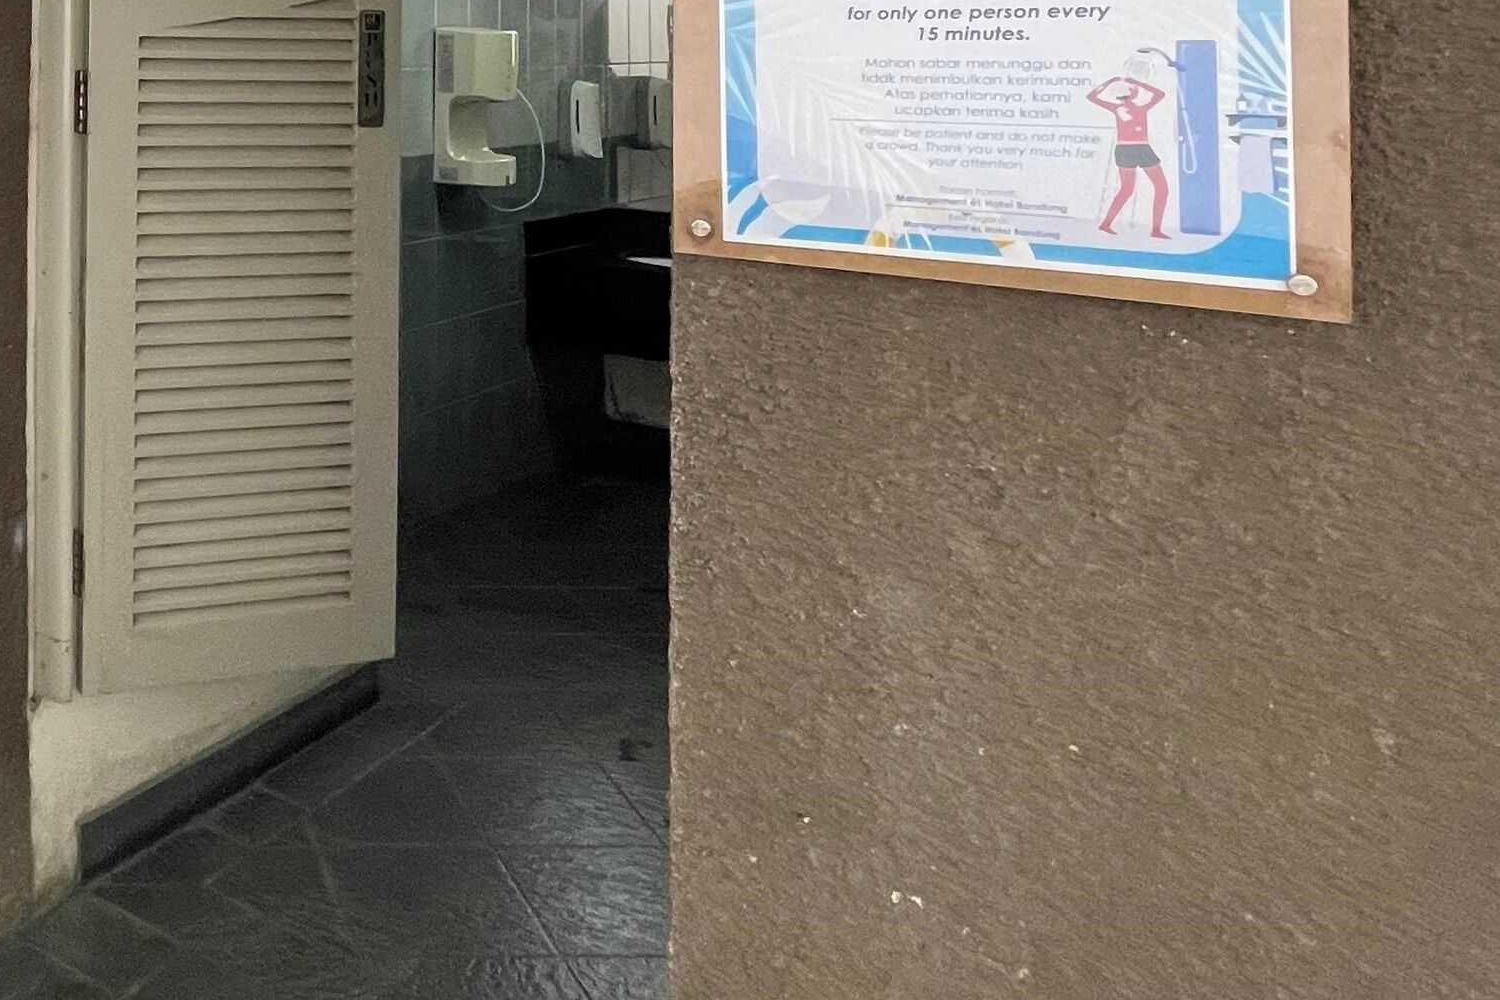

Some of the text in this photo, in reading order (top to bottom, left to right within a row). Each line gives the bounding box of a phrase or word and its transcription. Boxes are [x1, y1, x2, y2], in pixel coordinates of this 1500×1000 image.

[847, 4, 1111, 23] for only one person every
[917, 25, 1031, 42] 15 minutes.
[864, 57, 1092, 72] Mohon sabar menunggu dan
[861, 73, 896, 85] tidak
[900, 73, 1003, 86] menimbulkan
[883, 89, 917, 100] Atas
[1032, 90, 1072, 103] kami
[894, 105, 1060, 119] ucapkan terima kasih
[903, 128, 921, 138] be
[924, 129, 973, 139] patient
[975, 130, 1004, 141] and
[1007, 131, 1028, 141] do
[1031, 132, 1055, 142] not
[1058, 133, 1101, 144] make
[925, 141, 963, 153] Thank
[967, 145, 993, 155] you
[996, 146, 1026, 156] very
[1029, 146, 1072, 158] much
[1075, 147, 1095, 159] for
[928, 158, 958, 169] your
